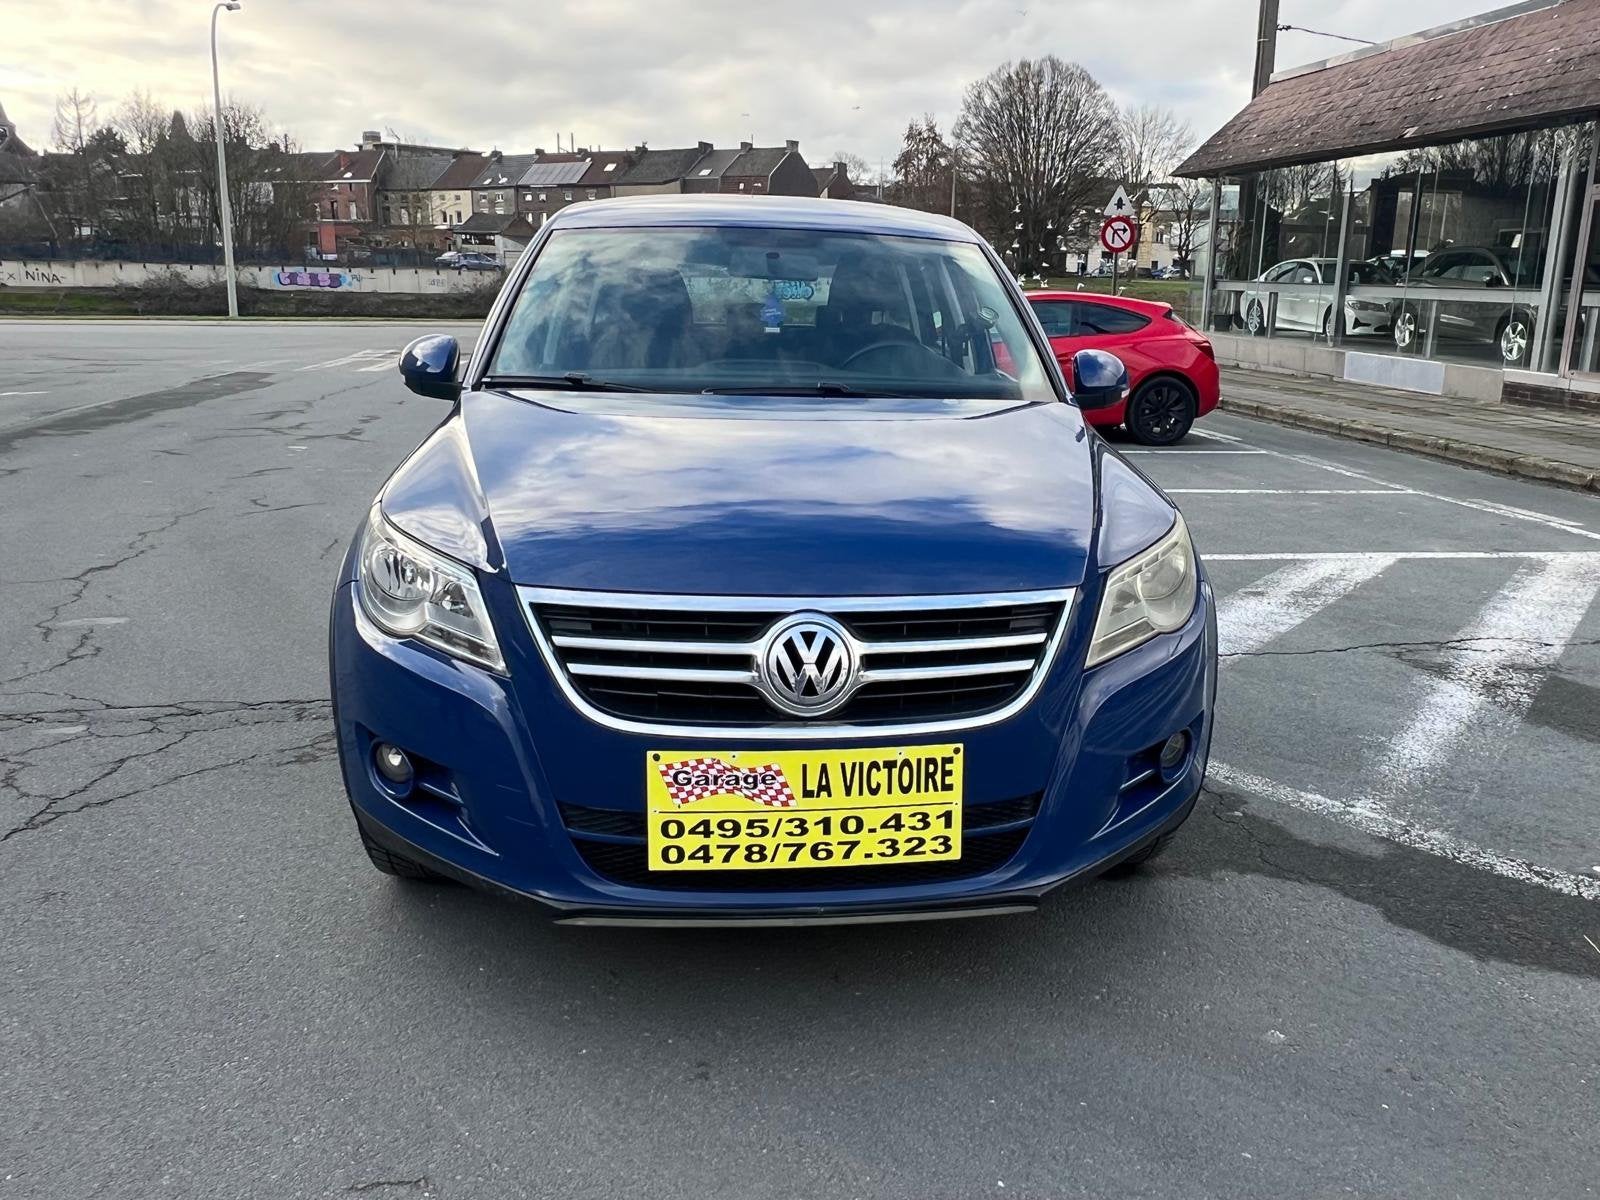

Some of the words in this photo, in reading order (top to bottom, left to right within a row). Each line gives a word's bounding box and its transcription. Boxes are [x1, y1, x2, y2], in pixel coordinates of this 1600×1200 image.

[770, 622, 848, 697] VW
[672, 770, 777, 790] Garage
[801, 763, 832, 799] LA
[840, 756, 955, 797] VICTOIRE
[660, 810, 954, 839] 0495/310.431
[660, 835, 953, 865] 0478/767.323
